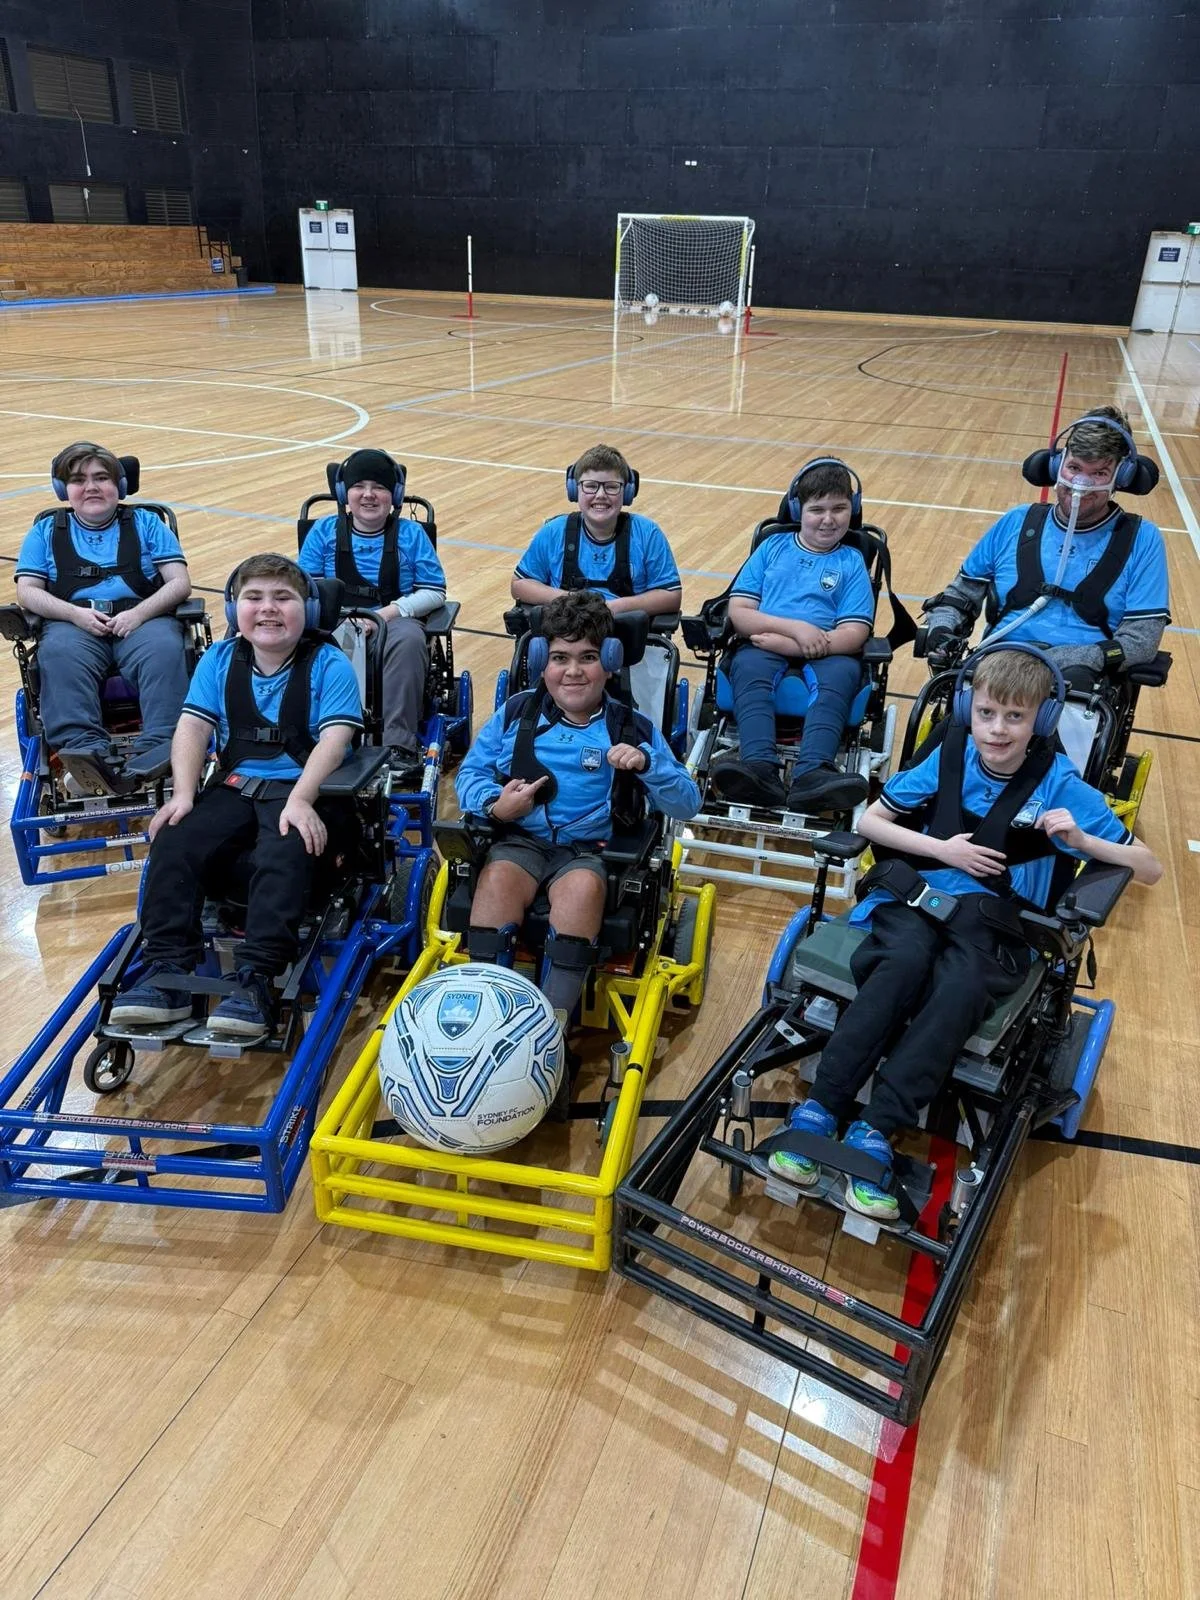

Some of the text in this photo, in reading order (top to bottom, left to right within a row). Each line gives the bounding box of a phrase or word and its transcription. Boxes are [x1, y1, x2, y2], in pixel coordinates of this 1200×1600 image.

[477, 1106, 519, 1120] SYDNEY FC
[477, 1105, 536, 1126] FOUNDATION
[279, 1104, 303, 1145] STRIKE
